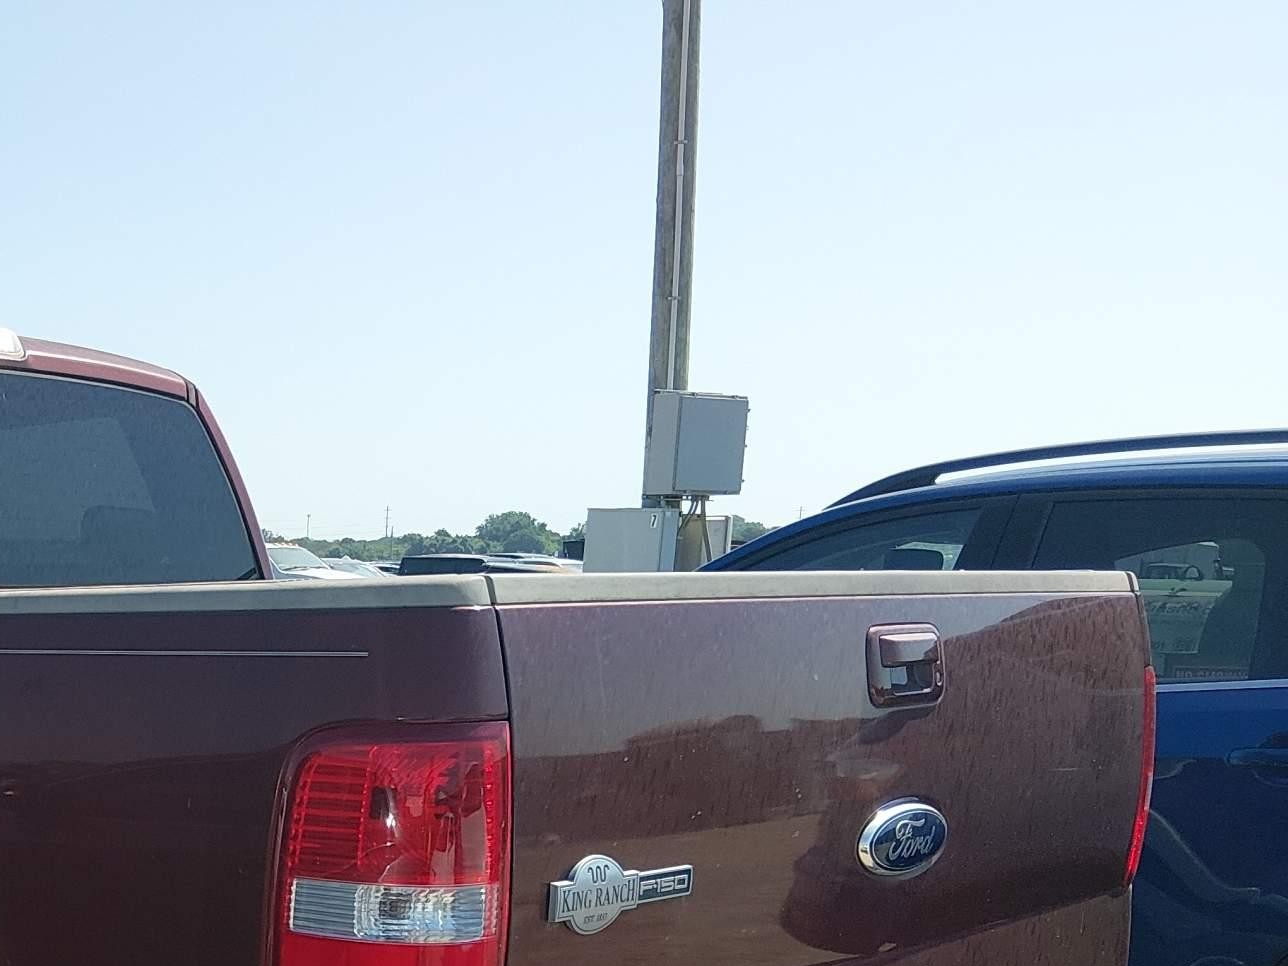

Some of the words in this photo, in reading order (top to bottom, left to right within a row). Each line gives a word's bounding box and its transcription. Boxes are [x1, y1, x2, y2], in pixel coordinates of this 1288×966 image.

[888, 818, 936, 861] Ford
[561, 889, 592, 913] KING
[595, 878, 635, 907] RANCH
